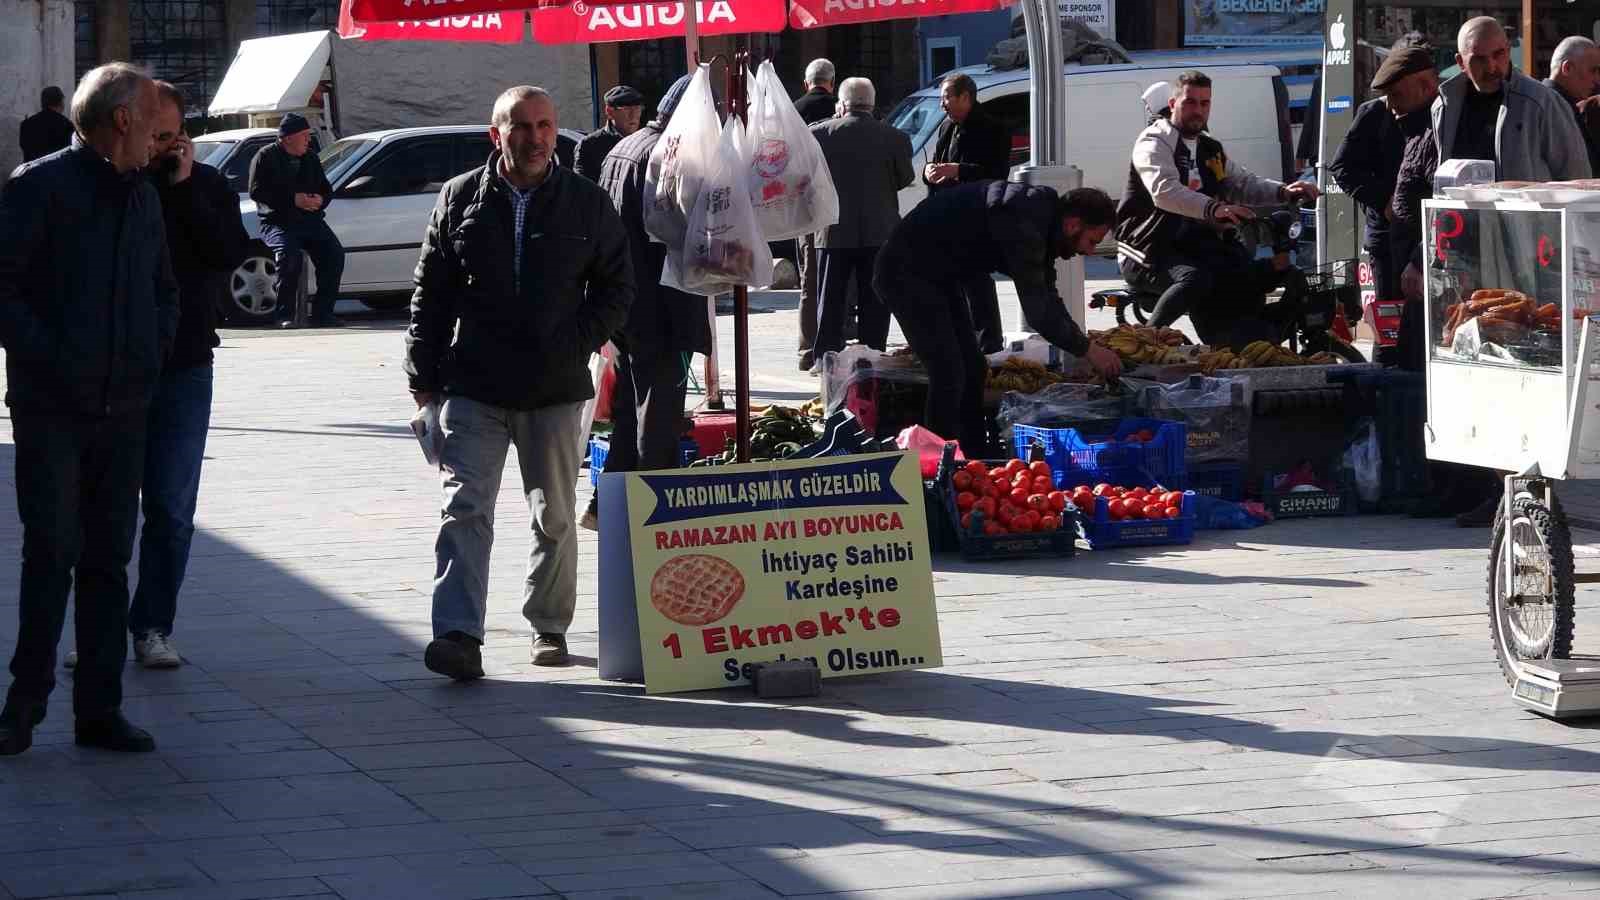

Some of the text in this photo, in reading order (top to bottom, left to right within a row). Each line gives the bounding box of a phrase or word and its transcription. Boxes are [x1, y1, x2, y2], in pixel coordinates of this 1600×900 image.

[1326, 49, 1351, 65] APPLE
[664, 468, 882, 508] YARDIMLAŞMAK GÜZELDİR
[655, 511, 904, 550] RAMAZAN AYI BOYUNCA
[761, 541, 914, 575] İhtiyaç Sahibi
[785, 574, 898, 600] Kardeşine
[662, 632, 683, 659] 1
[827, 647, 925, 672] Olsun...
